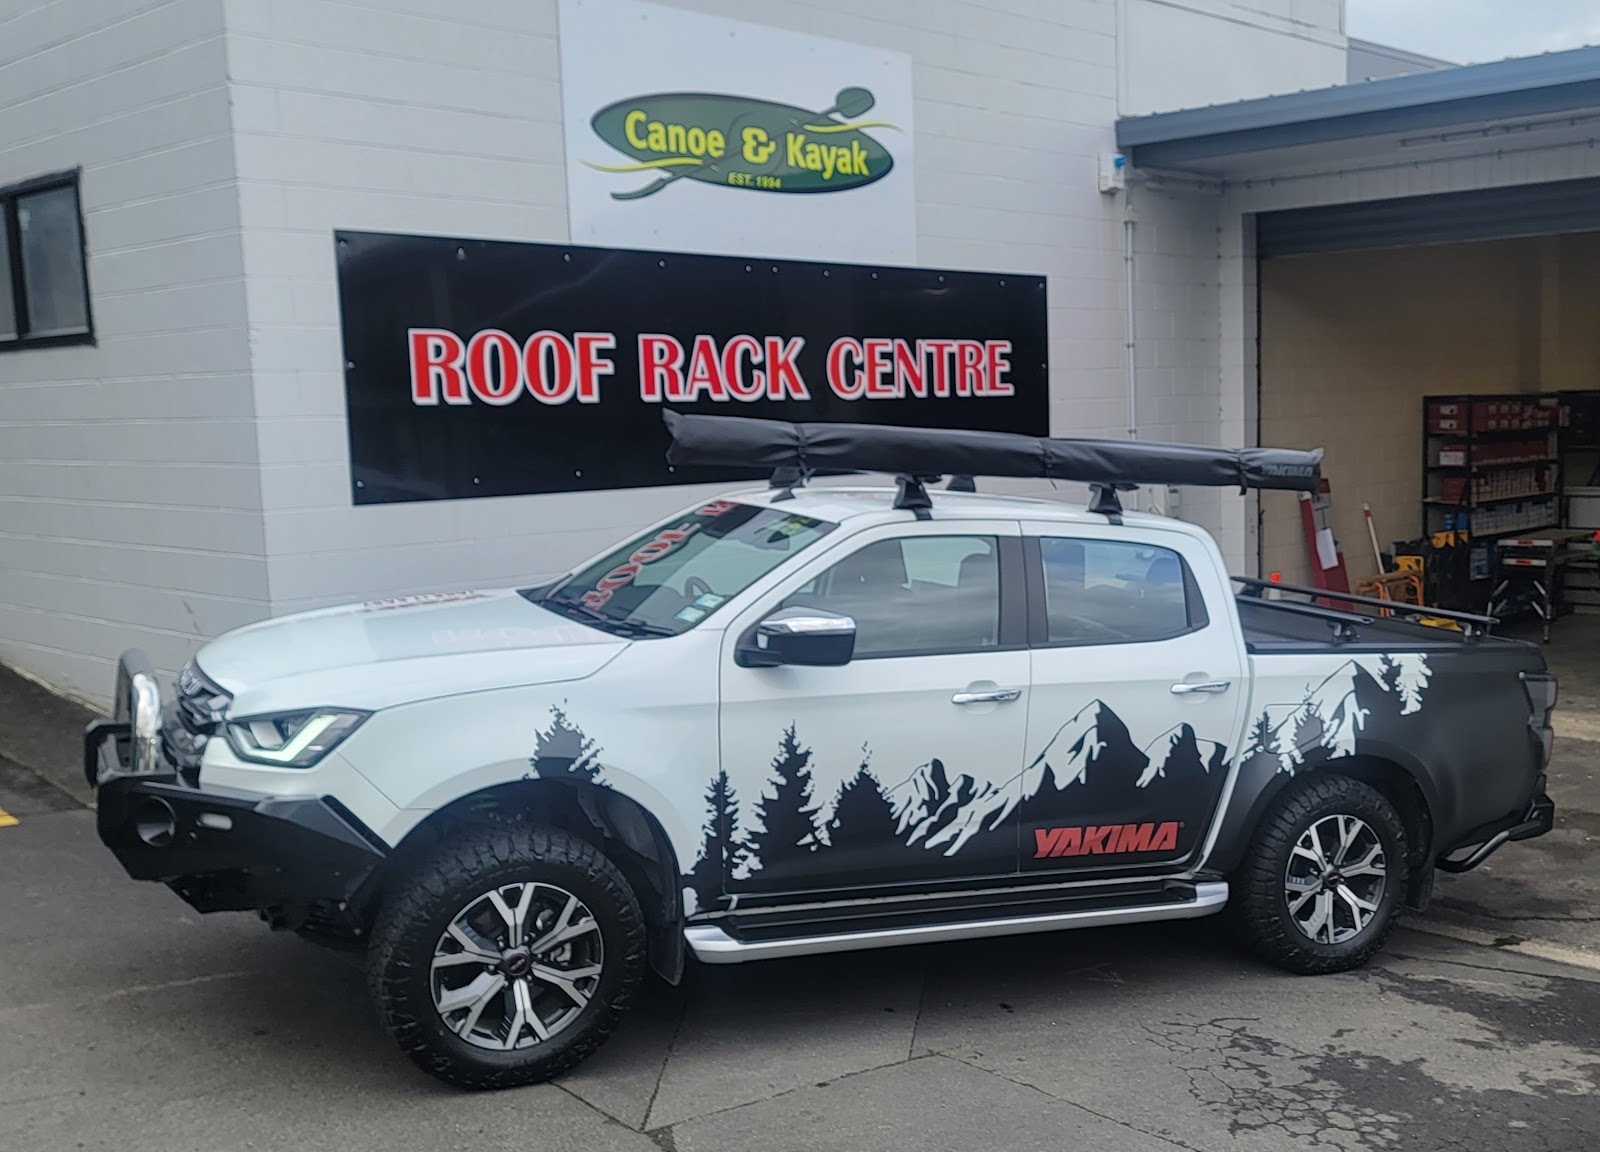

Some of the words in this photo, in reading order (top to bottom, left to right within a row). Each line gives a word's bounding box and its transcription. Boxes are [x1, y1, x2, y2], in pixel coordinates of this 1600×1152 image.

[625, 110, 725, 158] Canoe
[742, 127, 776, 164] &
[786, 132, 869, 180] Kayak
[408, 328, 616, 406] ROOF
[637, 333, 809, 403] RACK
[826, 336, 1015, 399] CENTRE
[1261, 464, 1314, 477] YAKIMA
[1033, 821, 1179, 859] YAKIMA
